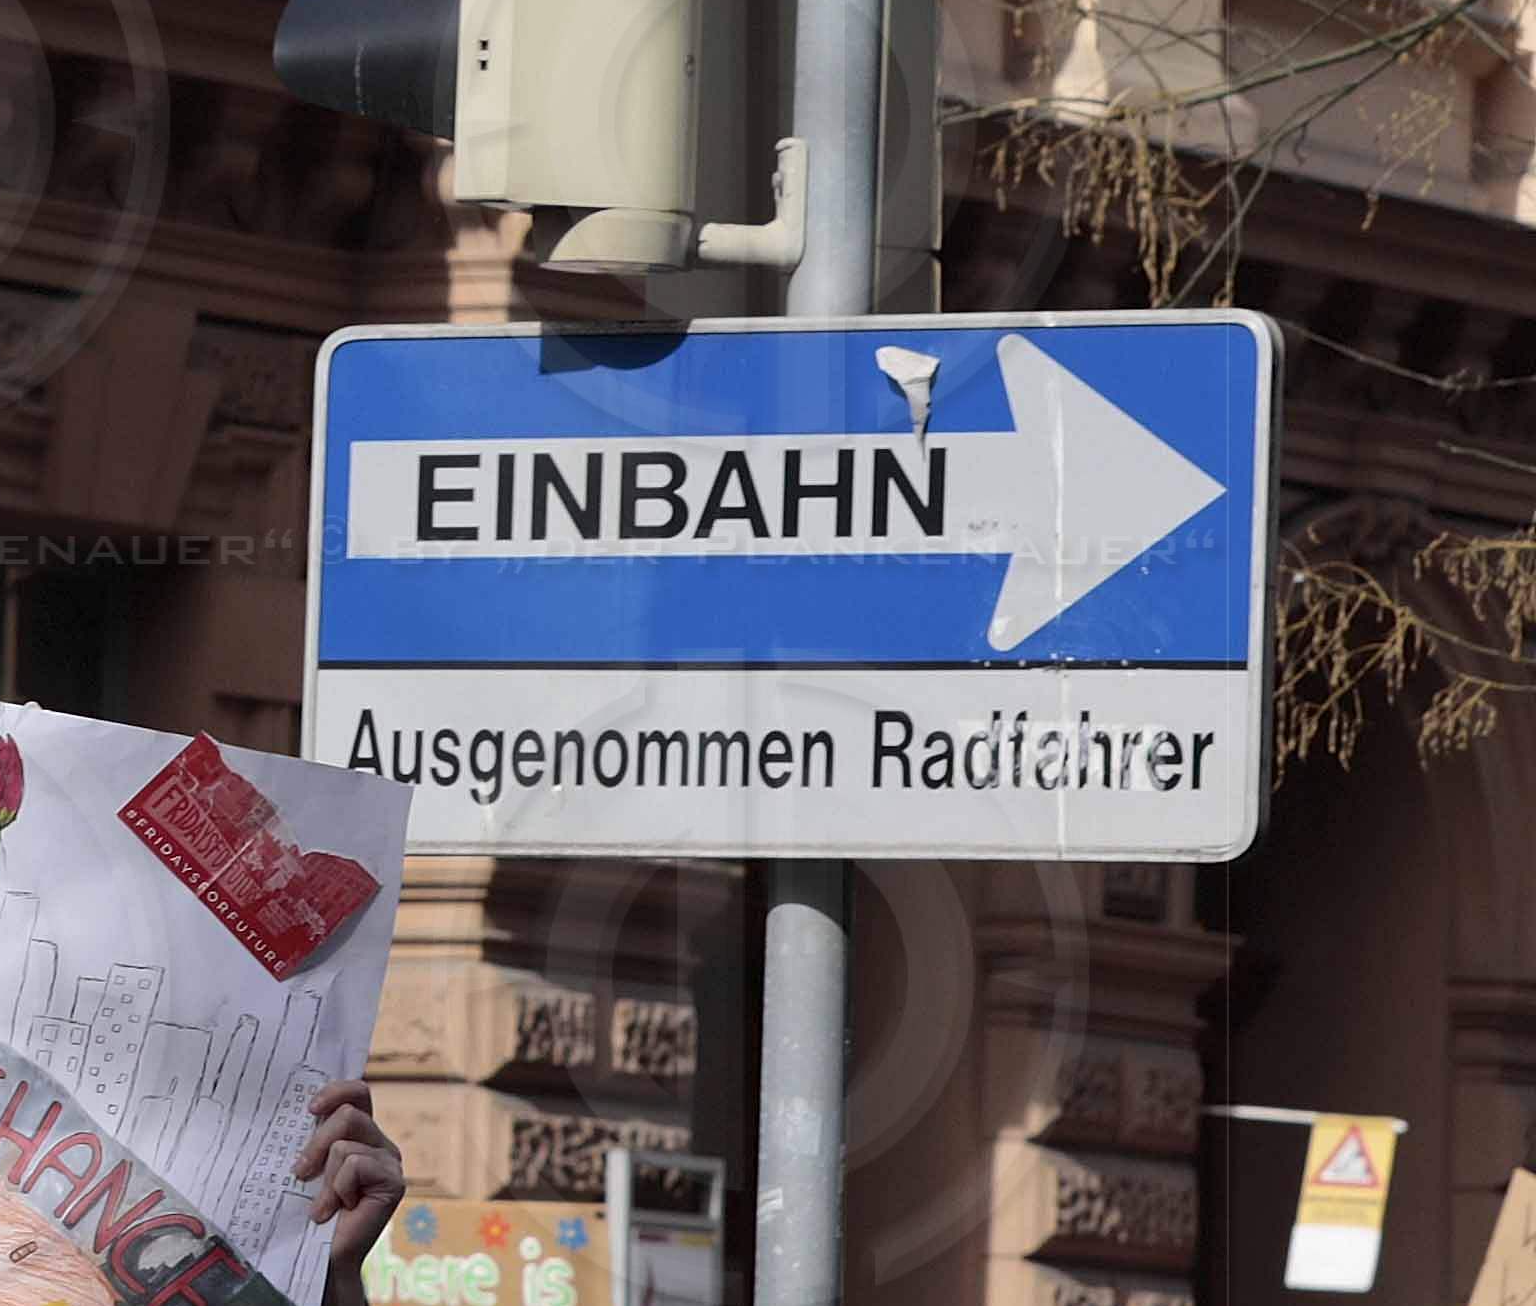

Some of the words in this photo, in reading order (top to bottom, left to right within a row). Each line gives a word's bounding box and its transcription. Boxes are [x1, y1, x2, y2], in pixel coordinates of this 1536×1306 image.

[414, 446, 947, 542] EINBAHN
[347, 708, 835, 804] Ausgenommen
[871, 709, 1215, 792] Radfahrer
[124, 808, 289, 974] #FRIDAYSFORFUTURE
